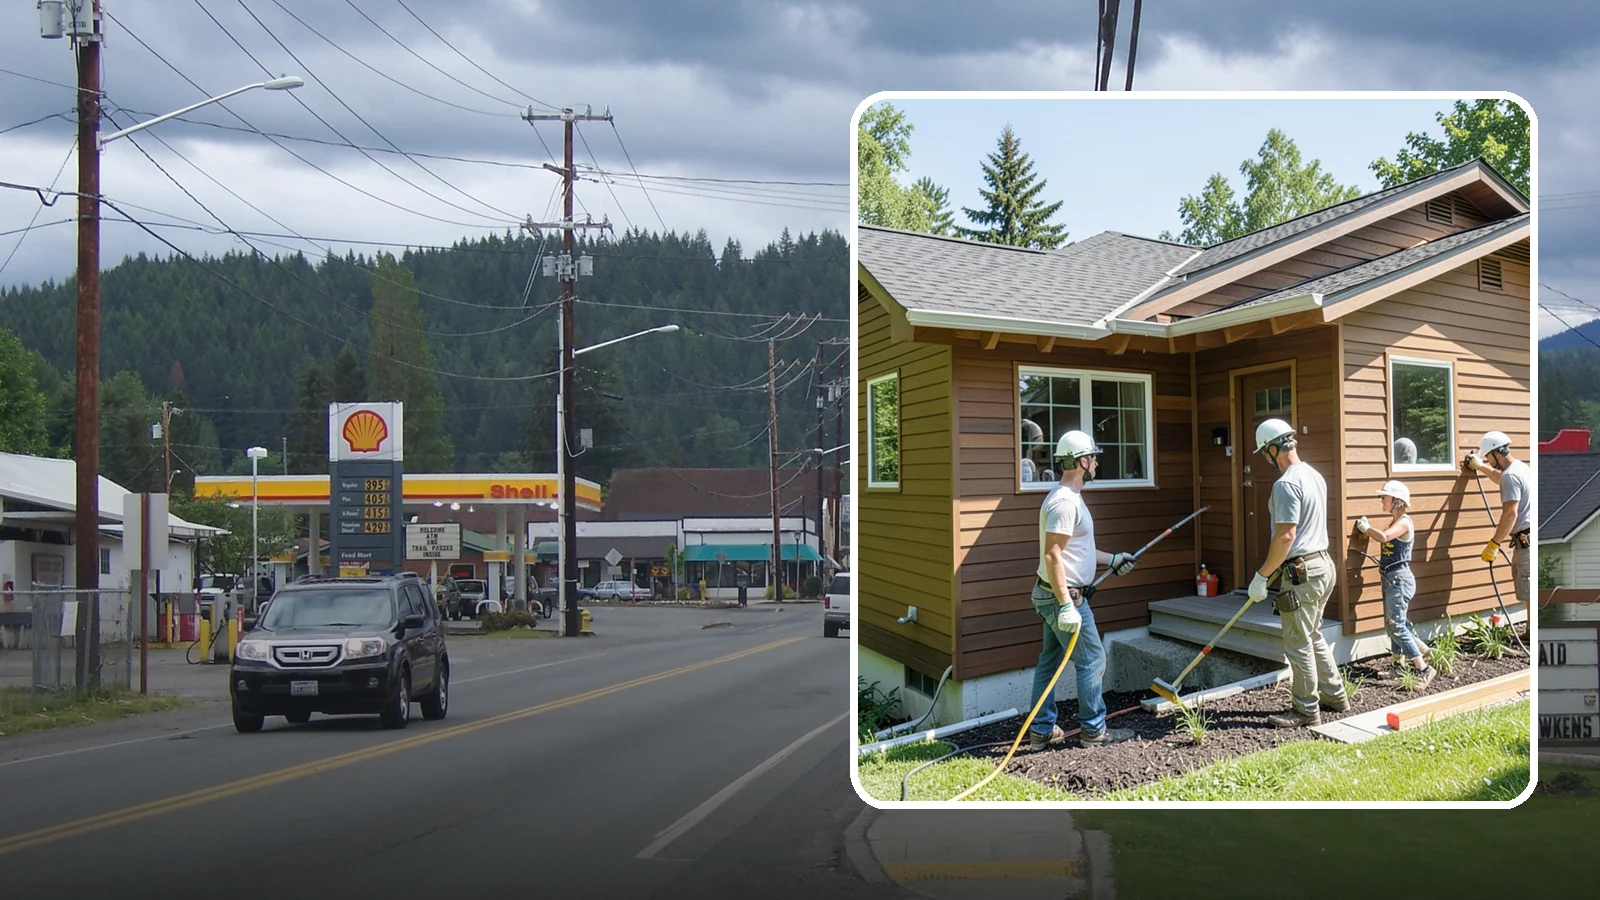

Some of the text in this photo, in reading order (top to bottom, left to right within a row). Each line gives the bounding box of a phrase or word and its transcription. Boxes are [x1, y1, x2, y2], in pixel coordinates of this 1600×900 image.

[366, 480, 383, 490] 395
[490, 484, 547, 499] Shell
[366, 495, 383, 504] 405
[366, 508, 383, 518] 415
[366, 522, 383, 533] 429
